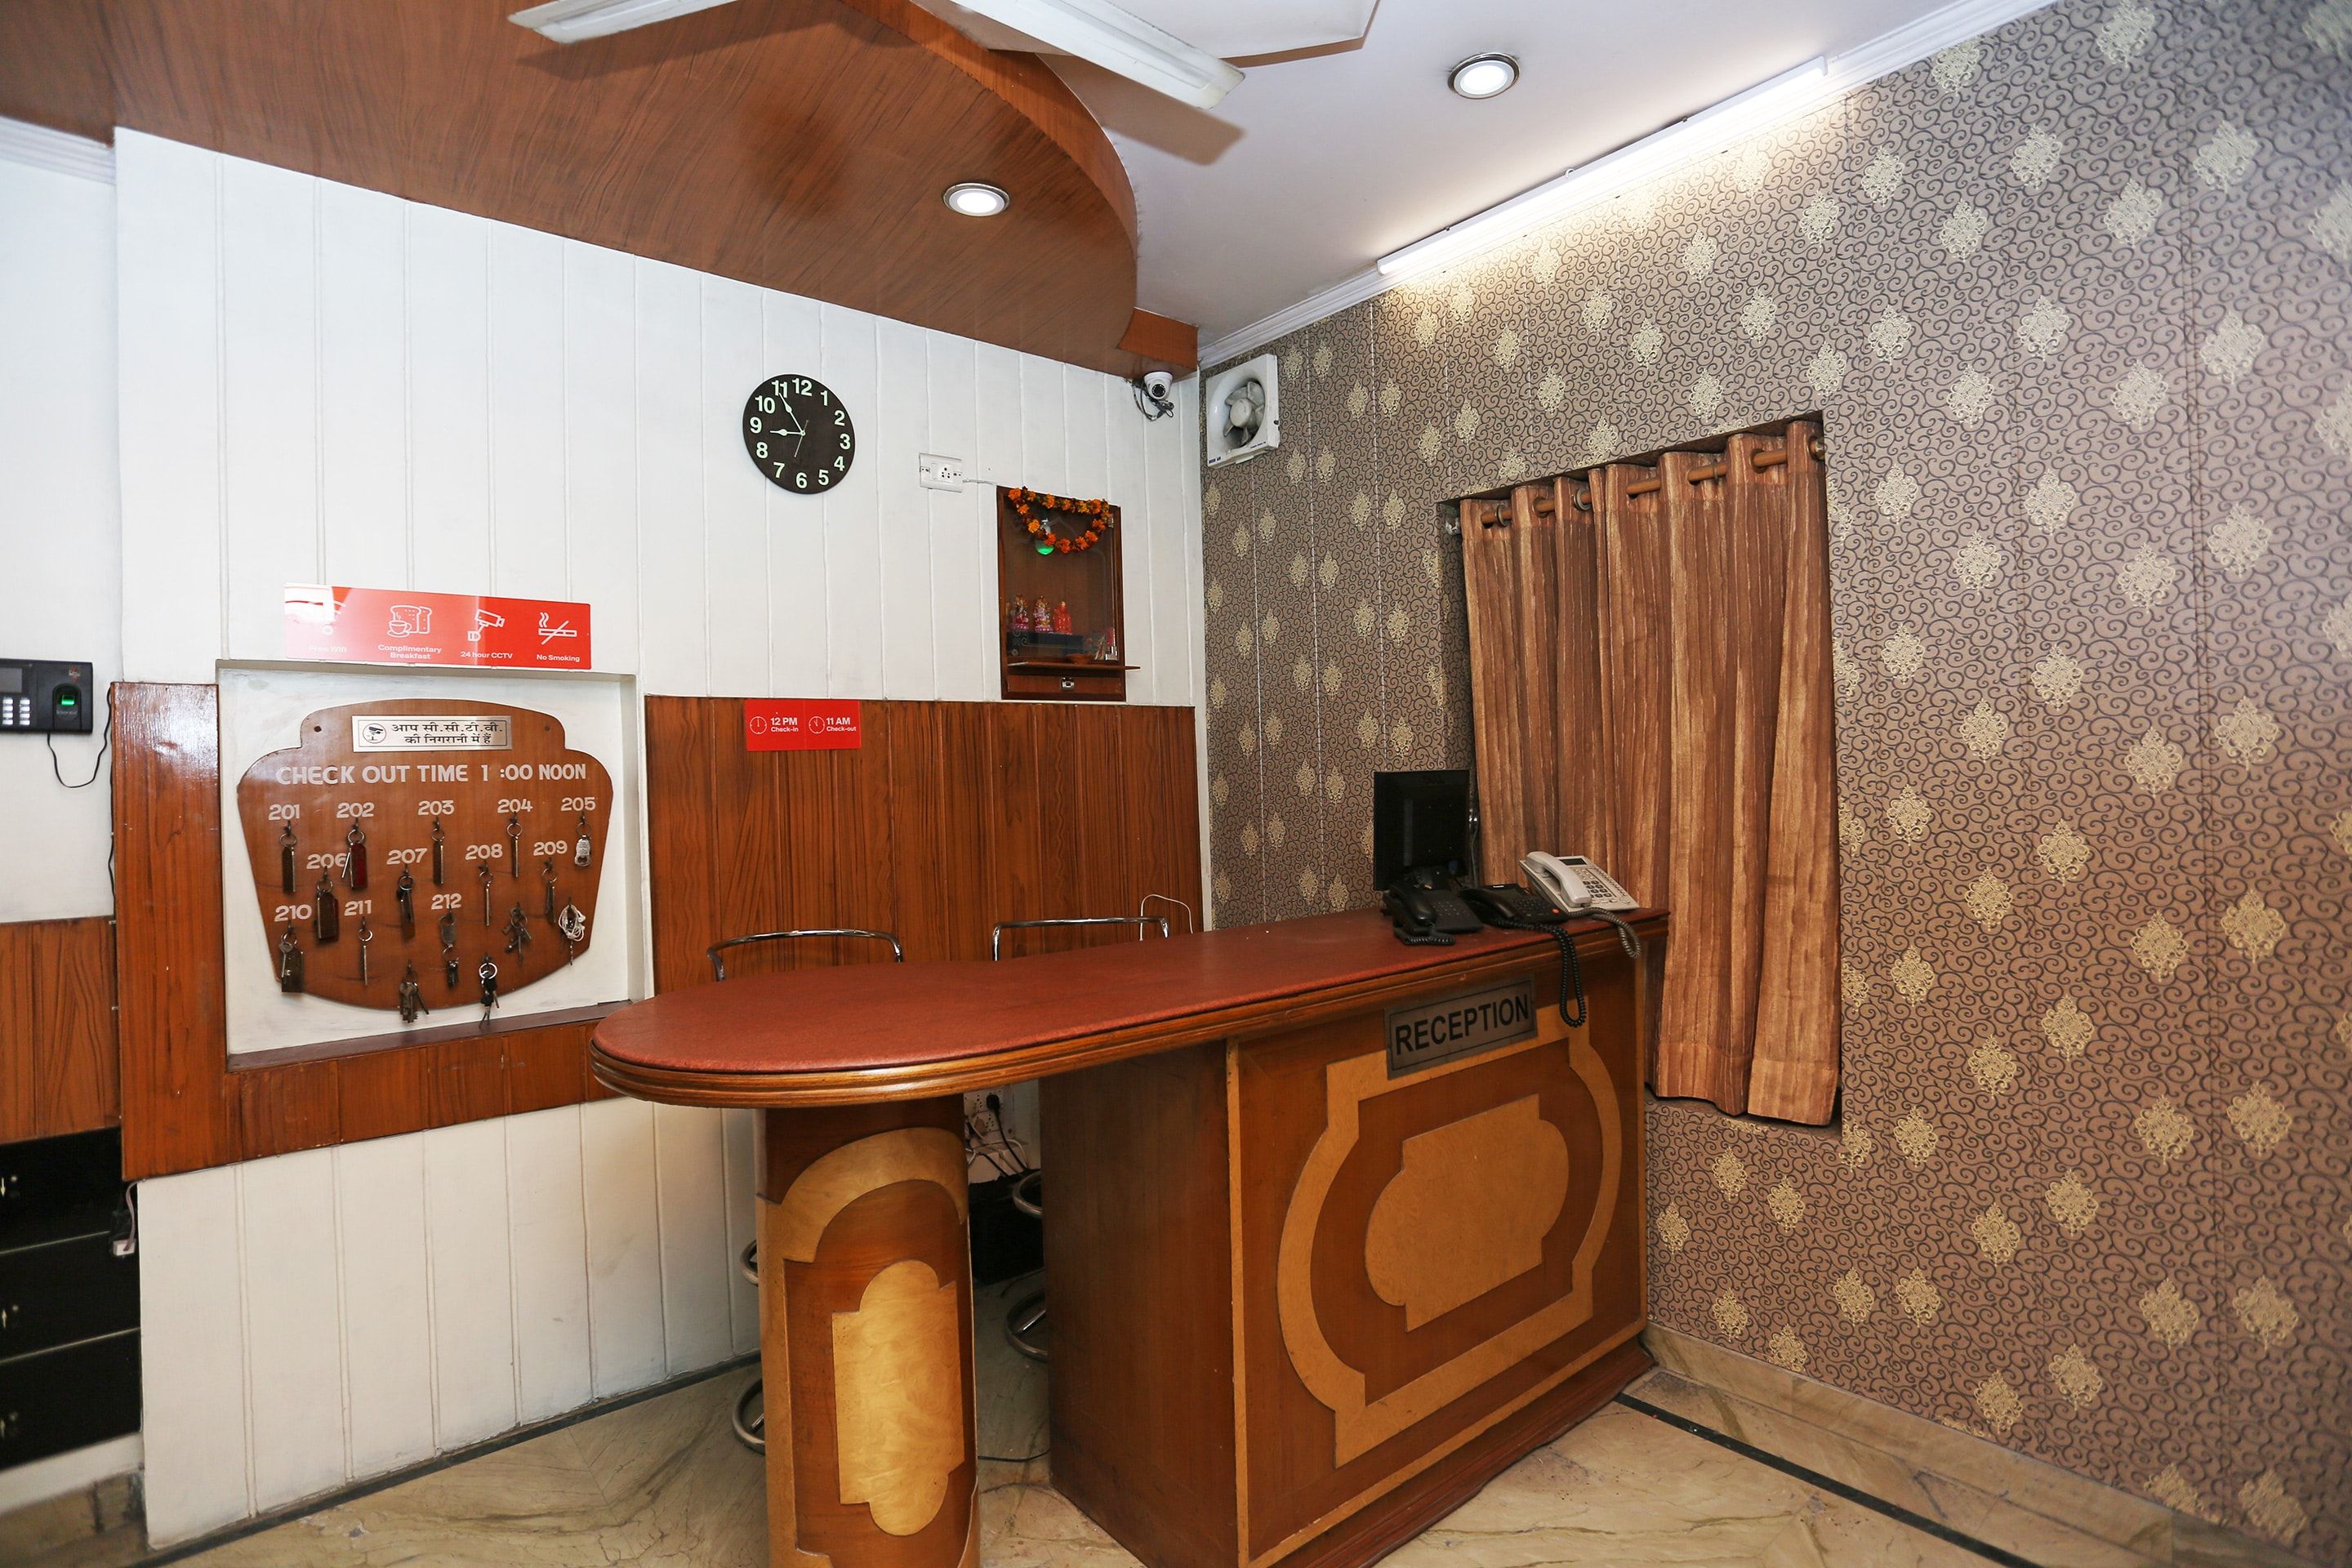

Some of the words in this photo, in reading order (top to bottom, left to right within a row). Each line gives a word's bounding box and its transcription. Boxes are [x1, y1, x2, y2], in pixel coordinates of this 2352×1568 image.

[772, 381, 788, 398] 11
[792, 378, 812, 396] 12
[755, 395, 775, 414] 10
[820, 390, 828, 406] 1
[750, 416, 762, 434] 9
[834, 410, 845, 426] 2
[756, 442, 768, 458] 8
[840, 433, 851, 450] 3
[773, 461, 785, 478] 7
[834, 456, 845, 471] 4
[795, 472, 808, 488] 6
[817, 470, 829, 485] 5
[378, 644, 442, 654] Complimentary
[548, 654, 581, 662] Smoking
[392, 724, 419, 732] आप
[770, 717, 781, 725] 12
[782, 717, 798, 725] PM
[826, 717, 834, 725] 11
[835, 717, 851, 725] AM
[404, 733, 420, 744] की
[425, 733, 468, 744] निगरानी
[471, 733, 480, 743] में
[483, 733, 492, 745] हैं
[275, 764, 355, 785] CHECK
[362, 765, 410, 784] OUT
[416, 764, 469, 782] TIME
[538, 764, 586, 781] NOON
[268, 804, 301, 821] 201
[336, 802, 375, 819] 202
[418, 800, 455, 816] 203
[497, 798, 532, 813] 204
[561, 796, 596, 812] 205
[386, 848, 428, 866] 207
[465, 843, 503, 861] 208
[533, 840, 568, 857] 209
[306, 853, 348, 870] 206
[344, 899, 372, 916] 211
[431, 893, 462, 911] 212
[274, 904, 312, 923] 210
[1395, 993, 1530, 1055] RECEPTION
